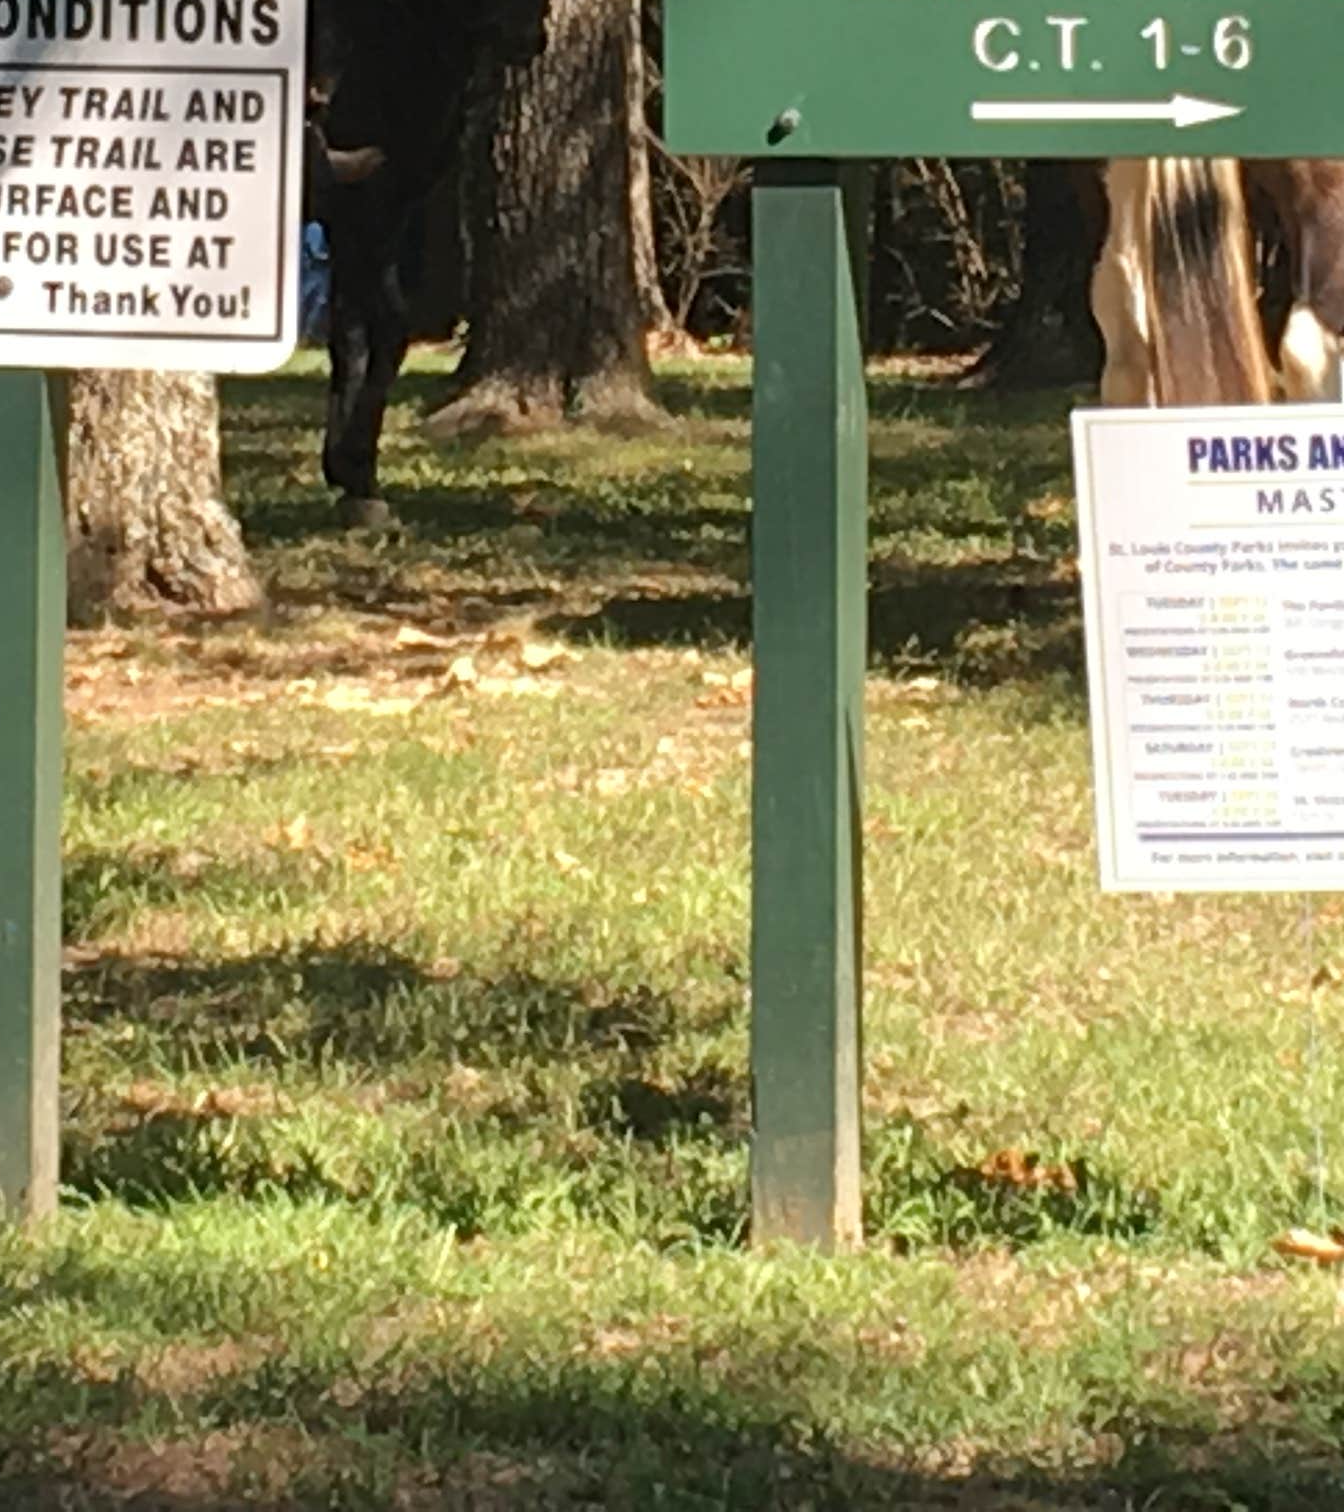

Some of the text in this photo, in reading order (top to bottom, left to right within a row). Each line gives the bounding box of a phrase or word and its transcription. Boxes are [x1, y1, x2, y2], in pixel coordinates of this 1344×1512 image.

[972, 17, 1253, 73] C.T. 1-6
[59, 86, 170, 122] TRAIL
[185, 89, 266, 124] AND
[51, 135, 161, 171] TRAIL
[176, 139, 256, 173] ARE
[148, 186, 229, 221] AND
[2, 231, 79, 265] FOR
[94, 234, 171, 268] USE
[187, 236, 236, 269] AT
[42, 281, 160, 317] Thank
[171, 284, 251, 320] You!
[1187, 435, 1299, 474] PARKS
